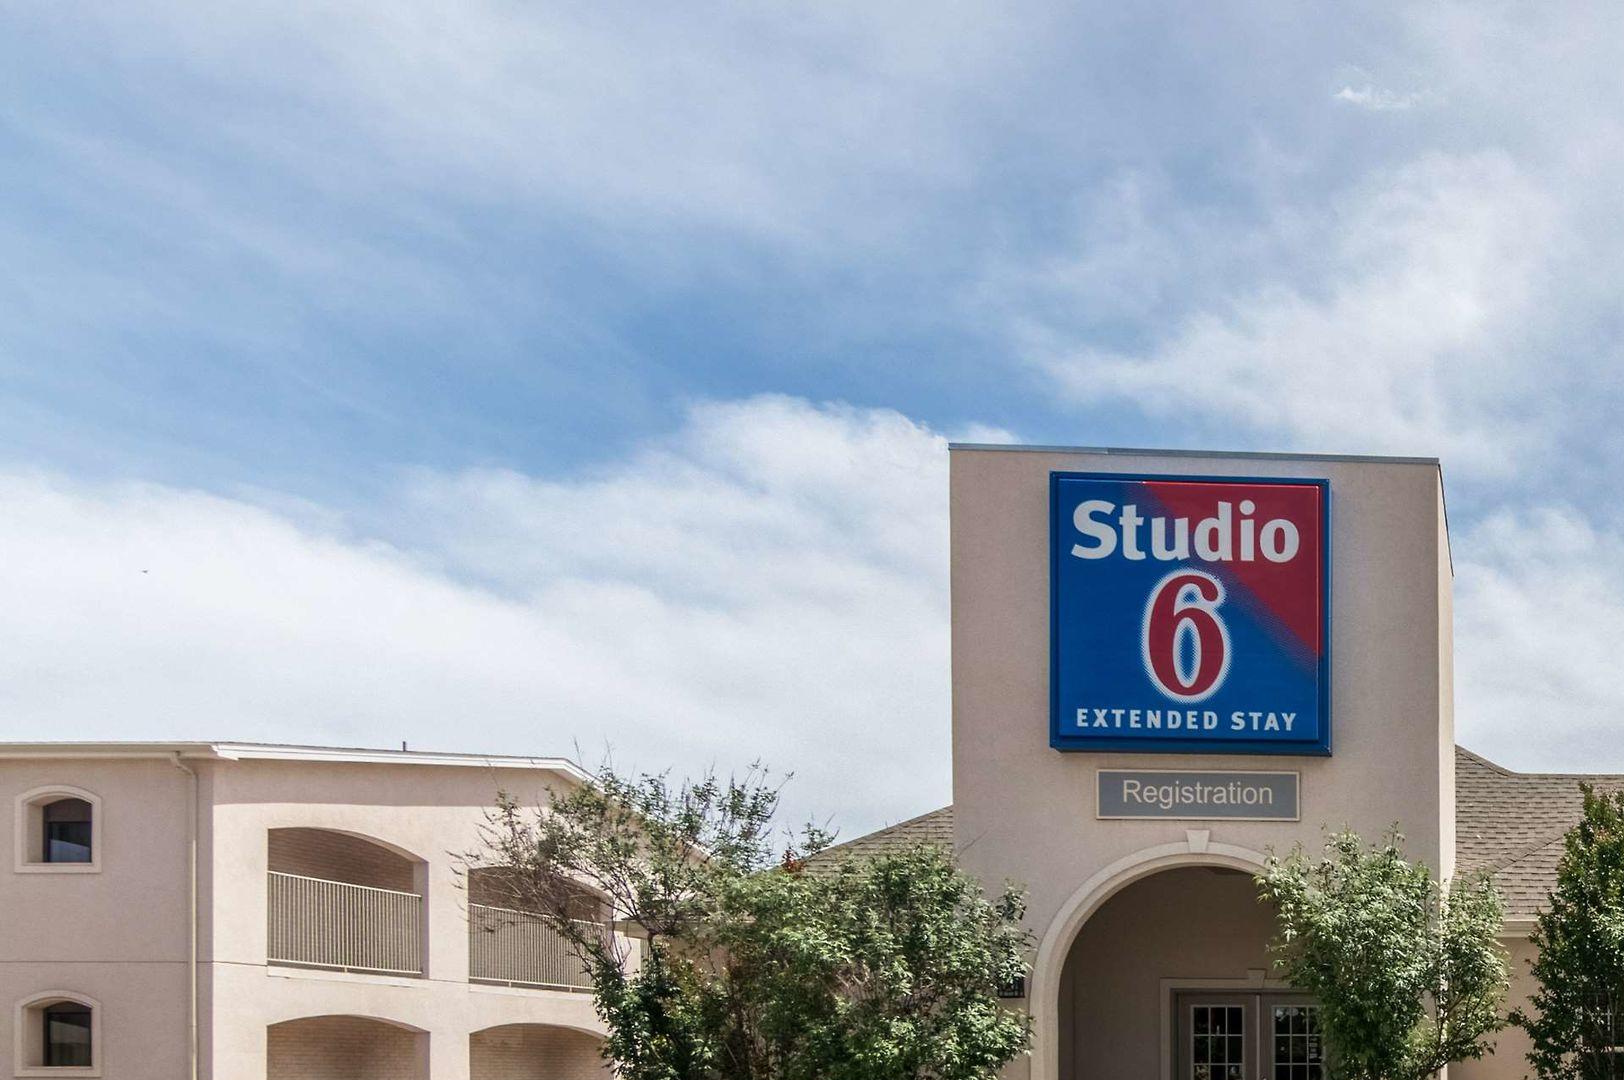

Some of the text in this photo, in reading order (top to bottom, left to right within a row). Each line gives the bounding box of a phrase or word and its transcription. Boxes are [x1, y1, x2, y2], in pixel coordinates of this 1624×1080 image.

[1071, 500, 1300, 563] Studio
[1143, 569, 1231, 703] 6
[1076, 708, 1297, 731] EXTENDED STAY
[1123, 779, 1273, 809] Registration
